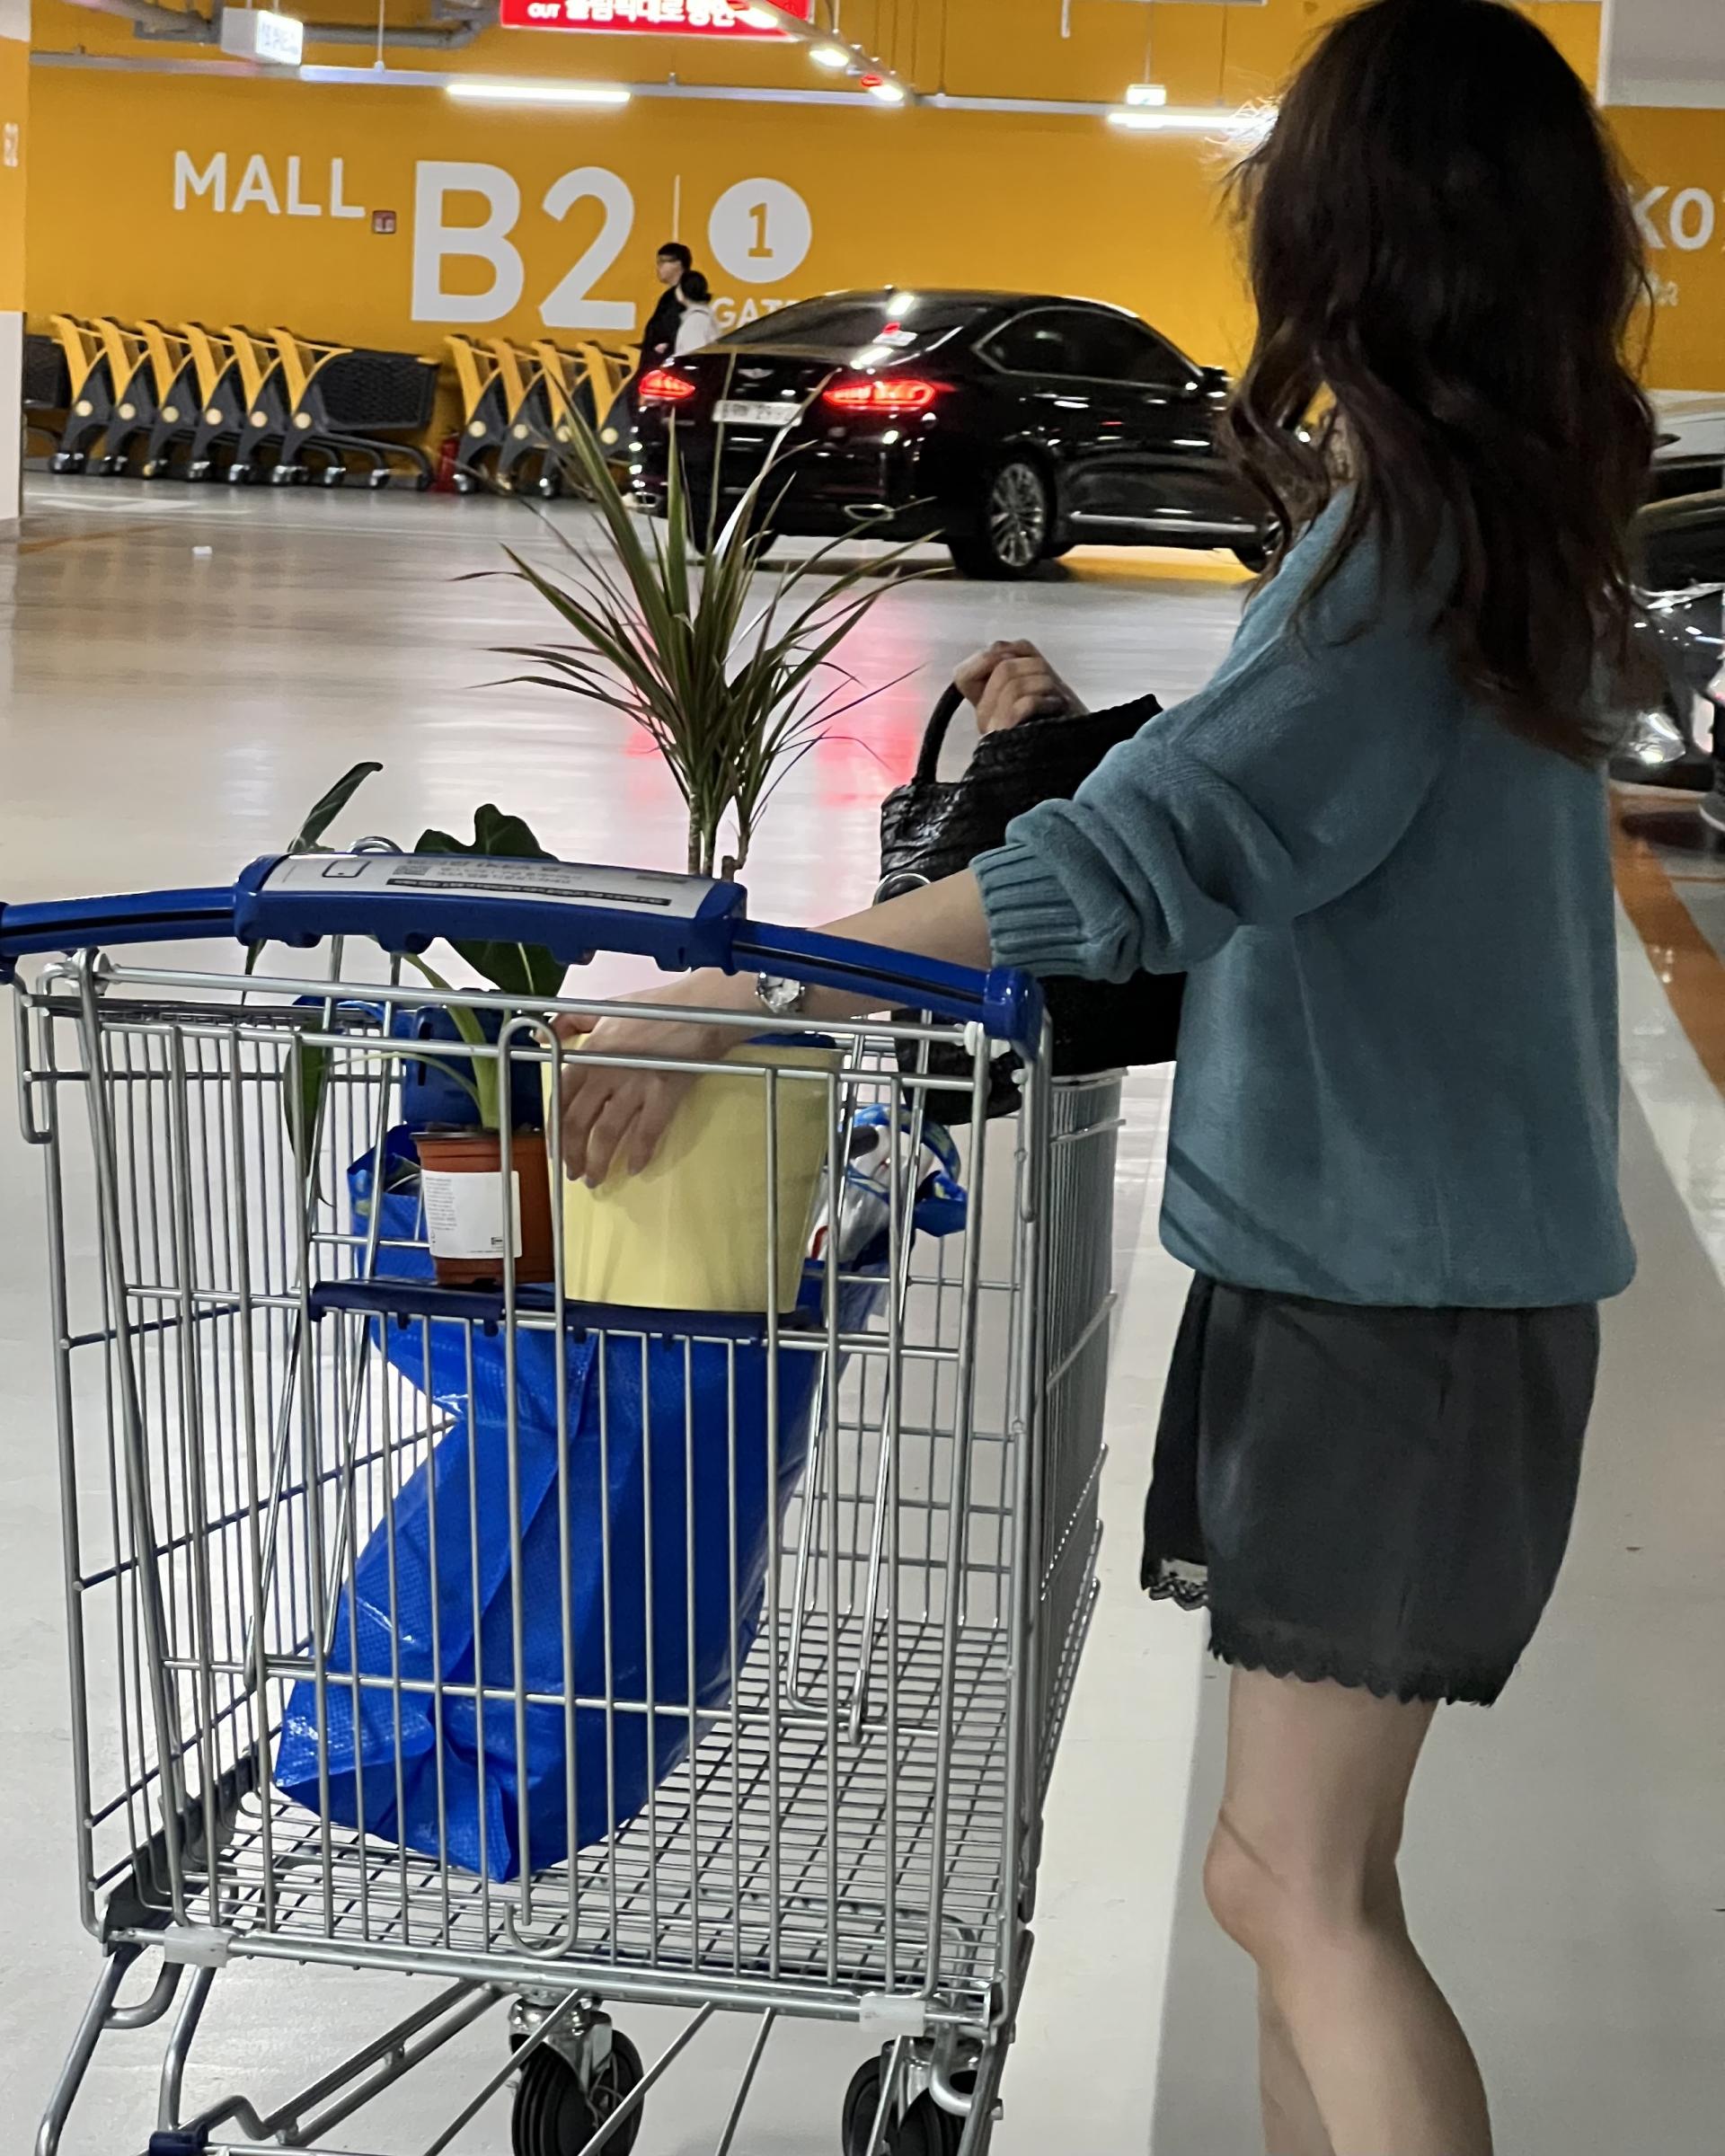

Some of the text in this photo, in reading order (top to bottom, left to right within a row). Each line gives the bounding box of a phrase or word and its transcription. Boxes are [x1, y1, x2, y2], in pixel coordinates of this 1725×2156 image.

[527, 3, 561, 19] OUT
[173, 149, 774, 331] MALL B2 1
[714, 296, 802, 331] GAT
